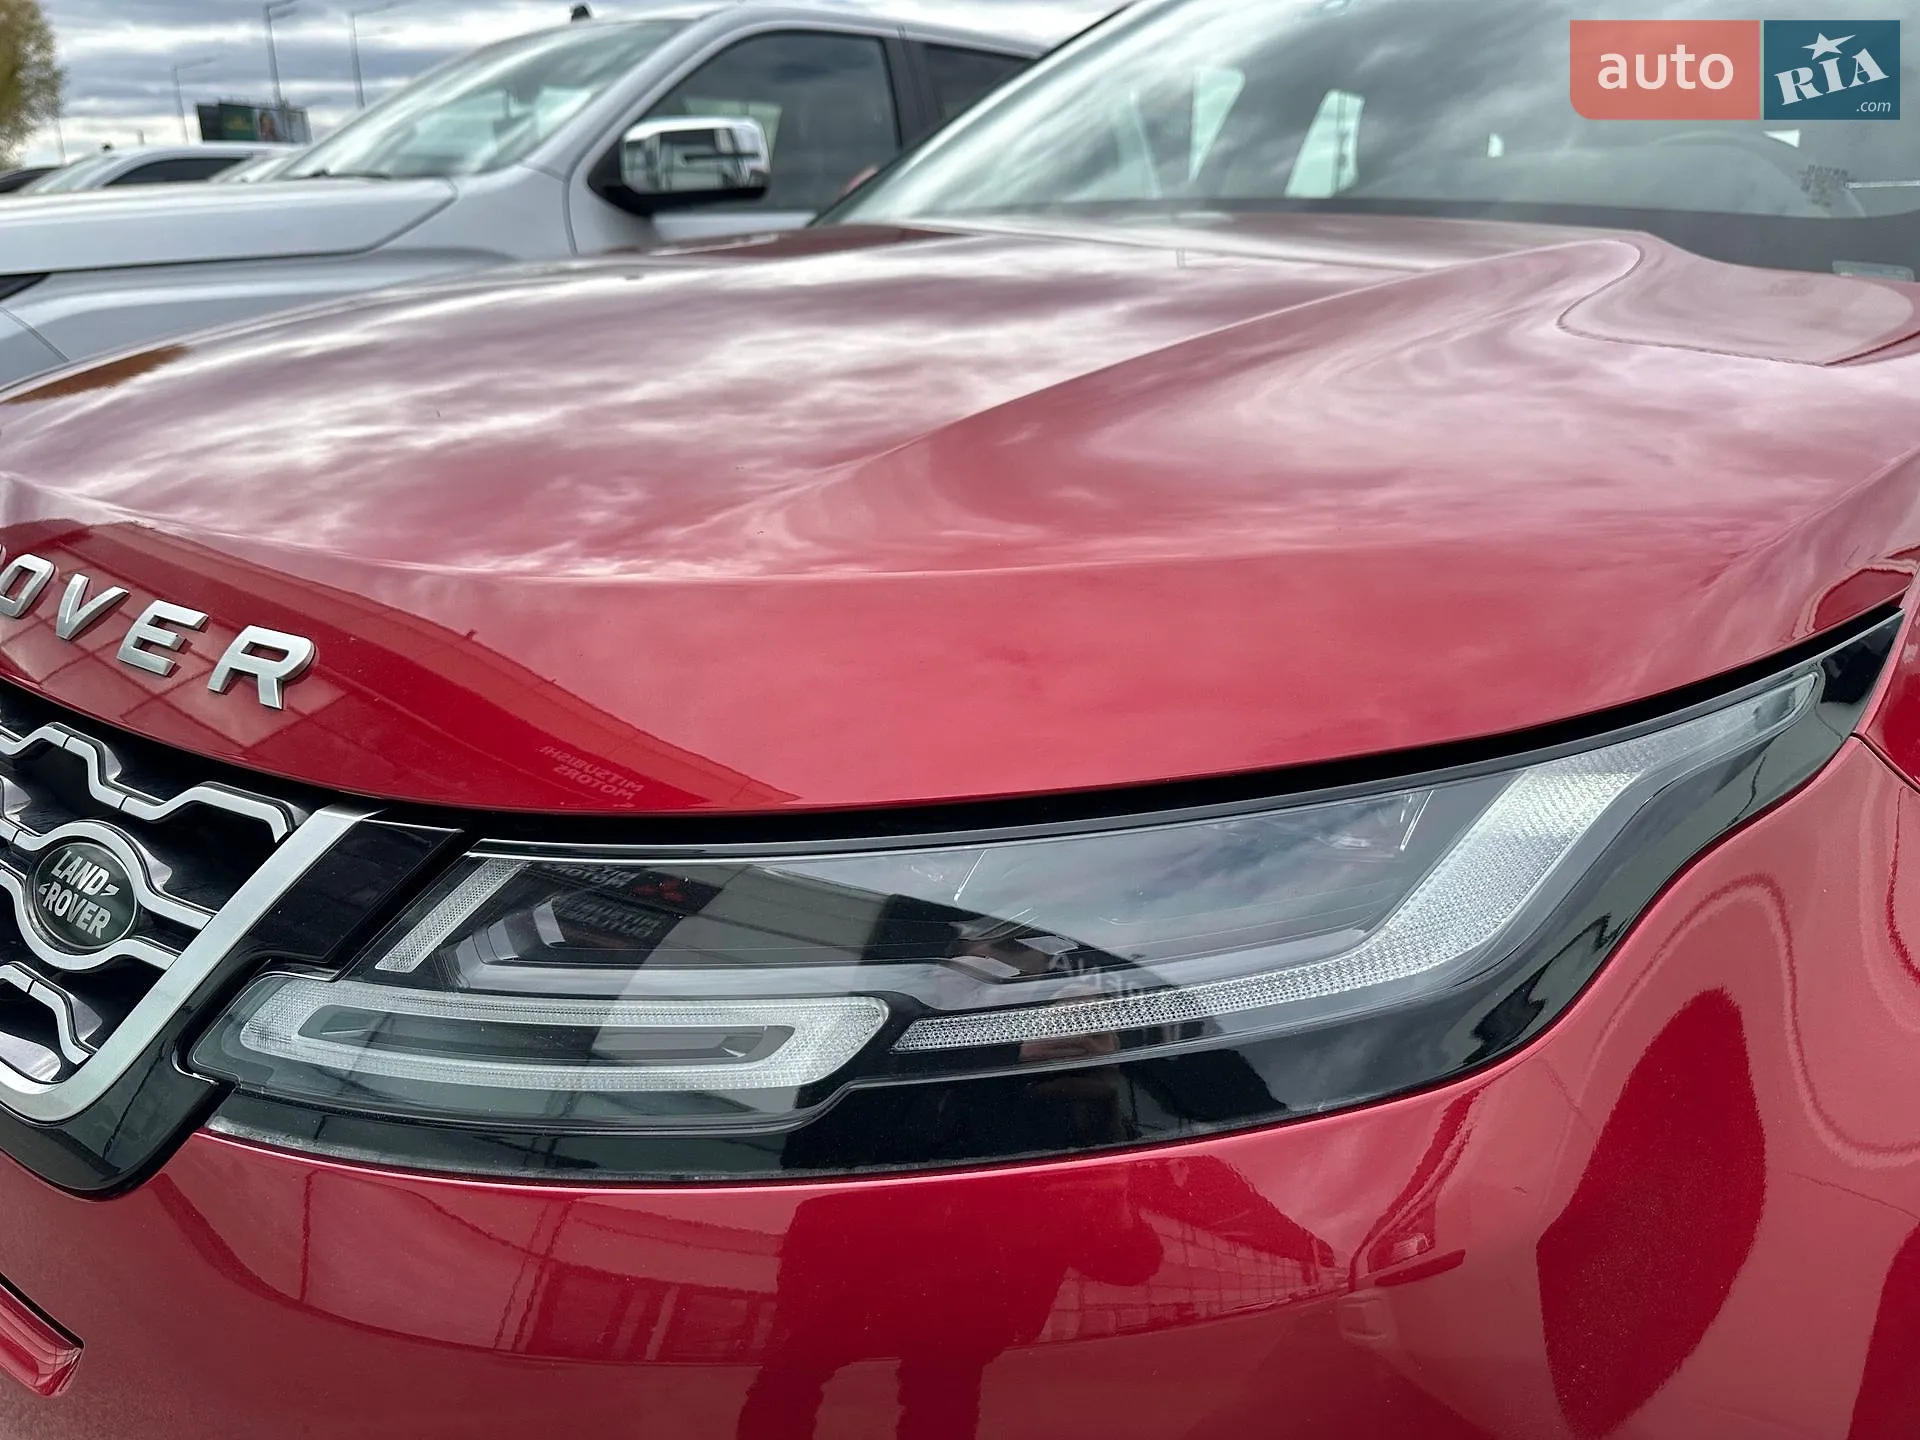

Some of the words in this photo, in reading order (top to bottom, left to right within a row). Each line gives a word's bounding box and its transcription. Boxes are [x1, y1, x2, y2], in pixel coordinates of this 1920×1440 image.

[0, 544, 315, 710] OVER
[50, 850, 110, 896] LAND
[42, 881, 111, 939] ROVER
